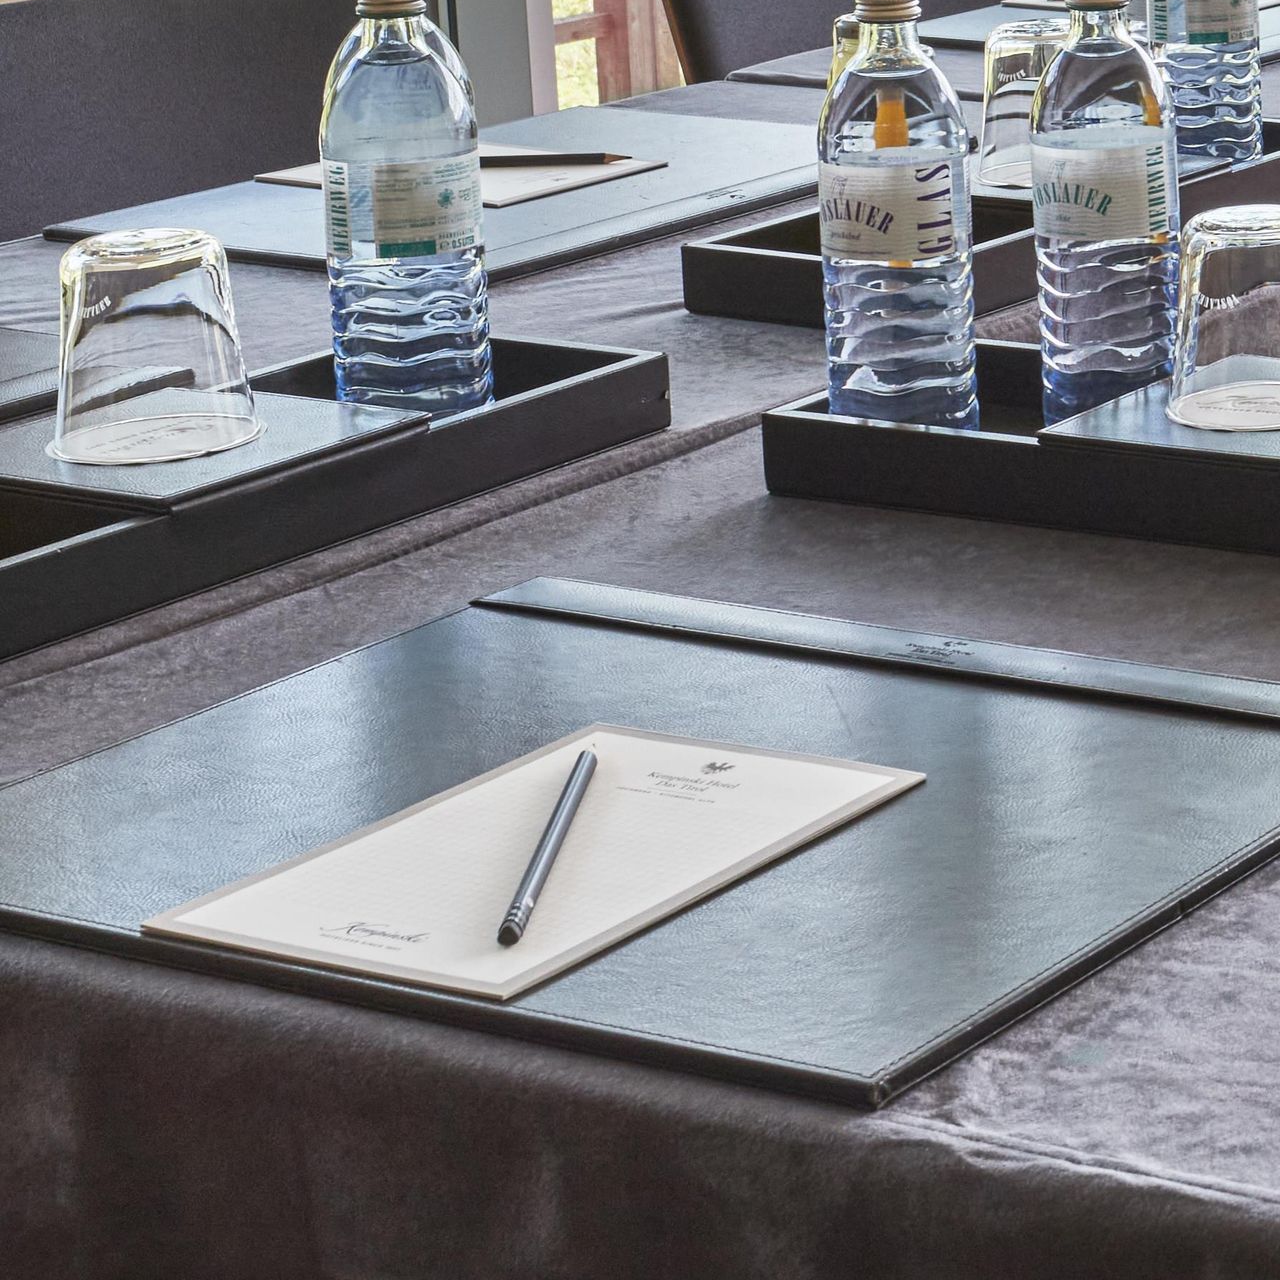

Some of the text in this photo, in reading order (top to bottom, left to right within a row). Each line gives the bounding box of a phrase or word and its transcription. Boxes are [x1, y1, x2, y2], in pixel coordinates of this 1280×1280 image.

[821, 197, 894, 235] ÖSLAUER
[914, 163, 953, 254] GLAS
[1145, 146, 1167, 232] MEHRWEG
